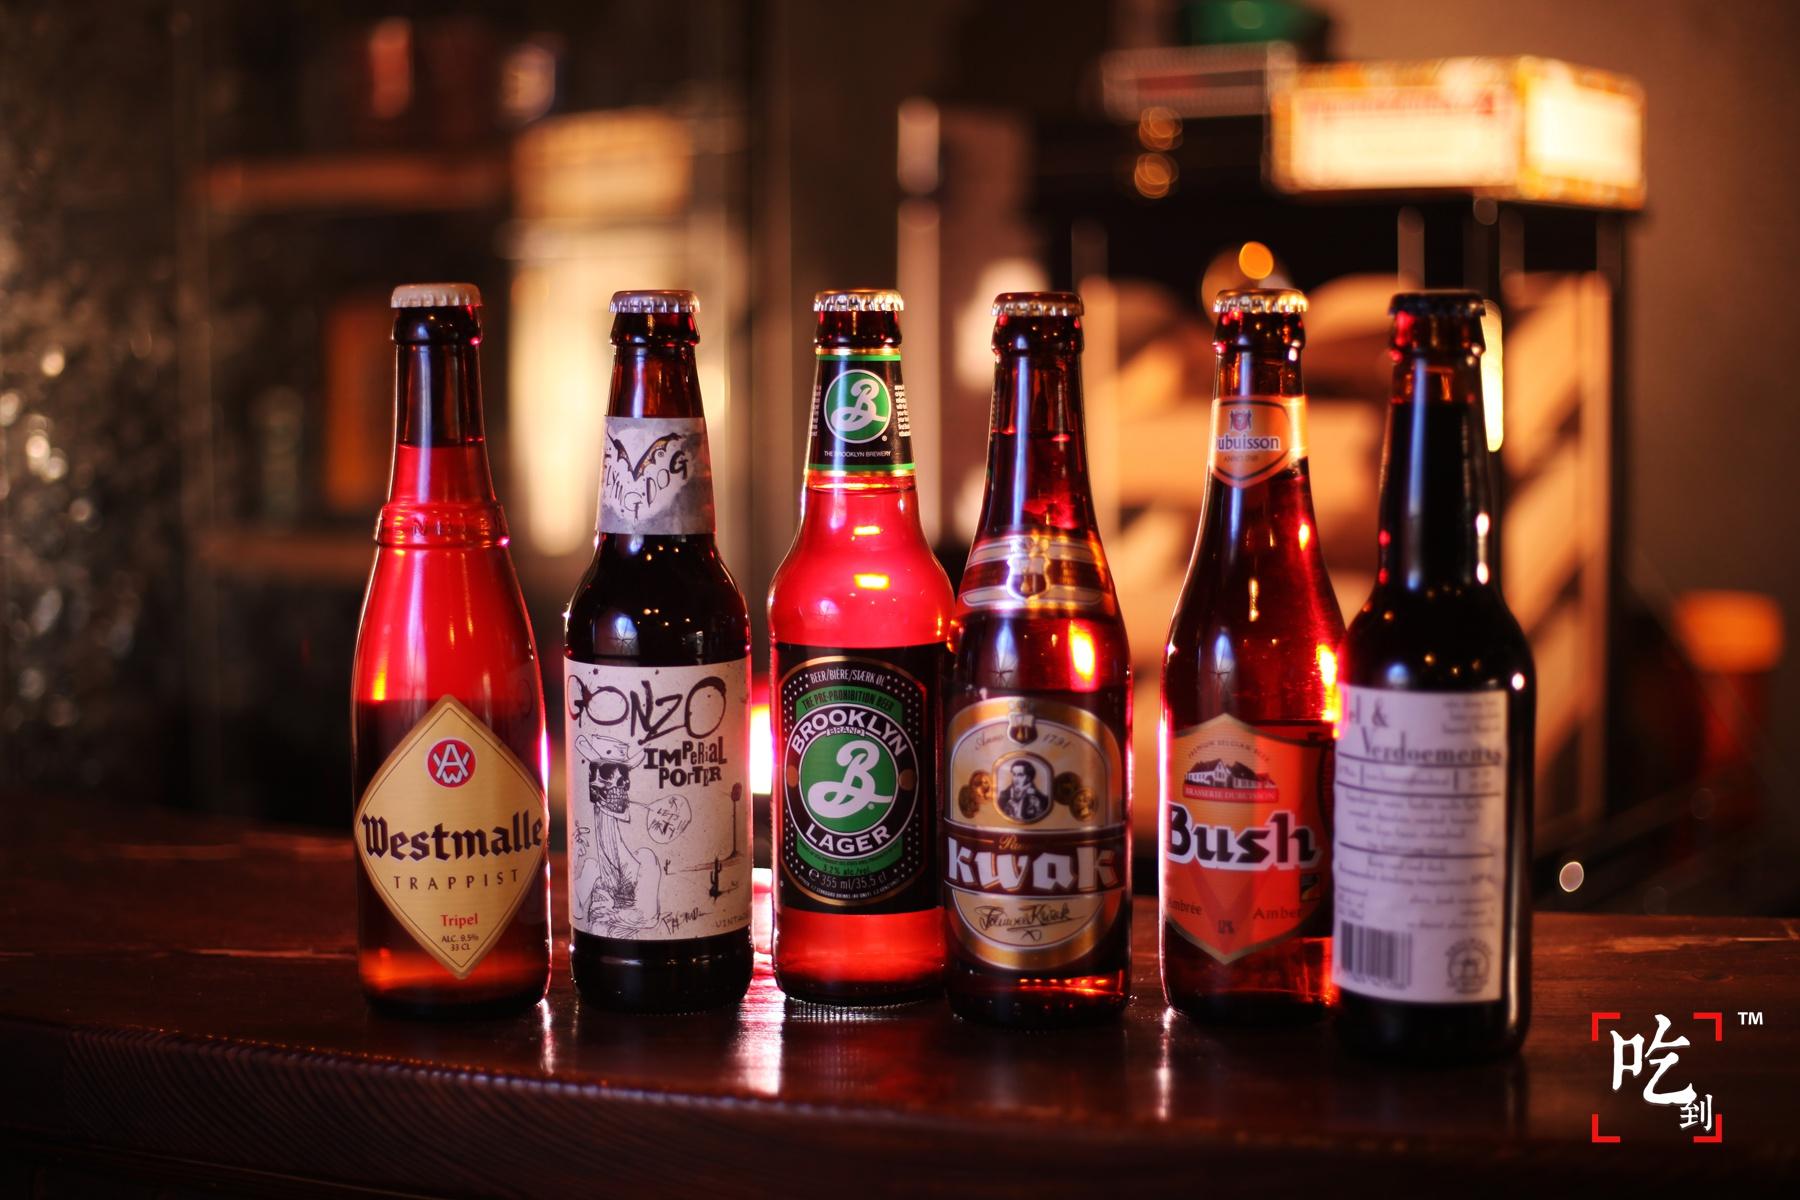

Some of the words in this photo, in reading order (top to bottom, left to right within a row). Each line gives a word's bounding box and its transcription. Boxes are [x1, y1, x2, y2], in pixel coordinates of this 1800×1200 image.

[1217, 434, 1279, 450] ubuisson
[567, 674, 725, 746] GONZO
[790, 707, 908, 757] BROOKLYN
[361, 808, 544, 862] Westmalle
[806, 822, 892, 854] LAGER
[1168, 803, 1320, 867] Bush
[393, 868, 519, 891] TRAPPIST
[440, 911, 479, 929] Tripel
